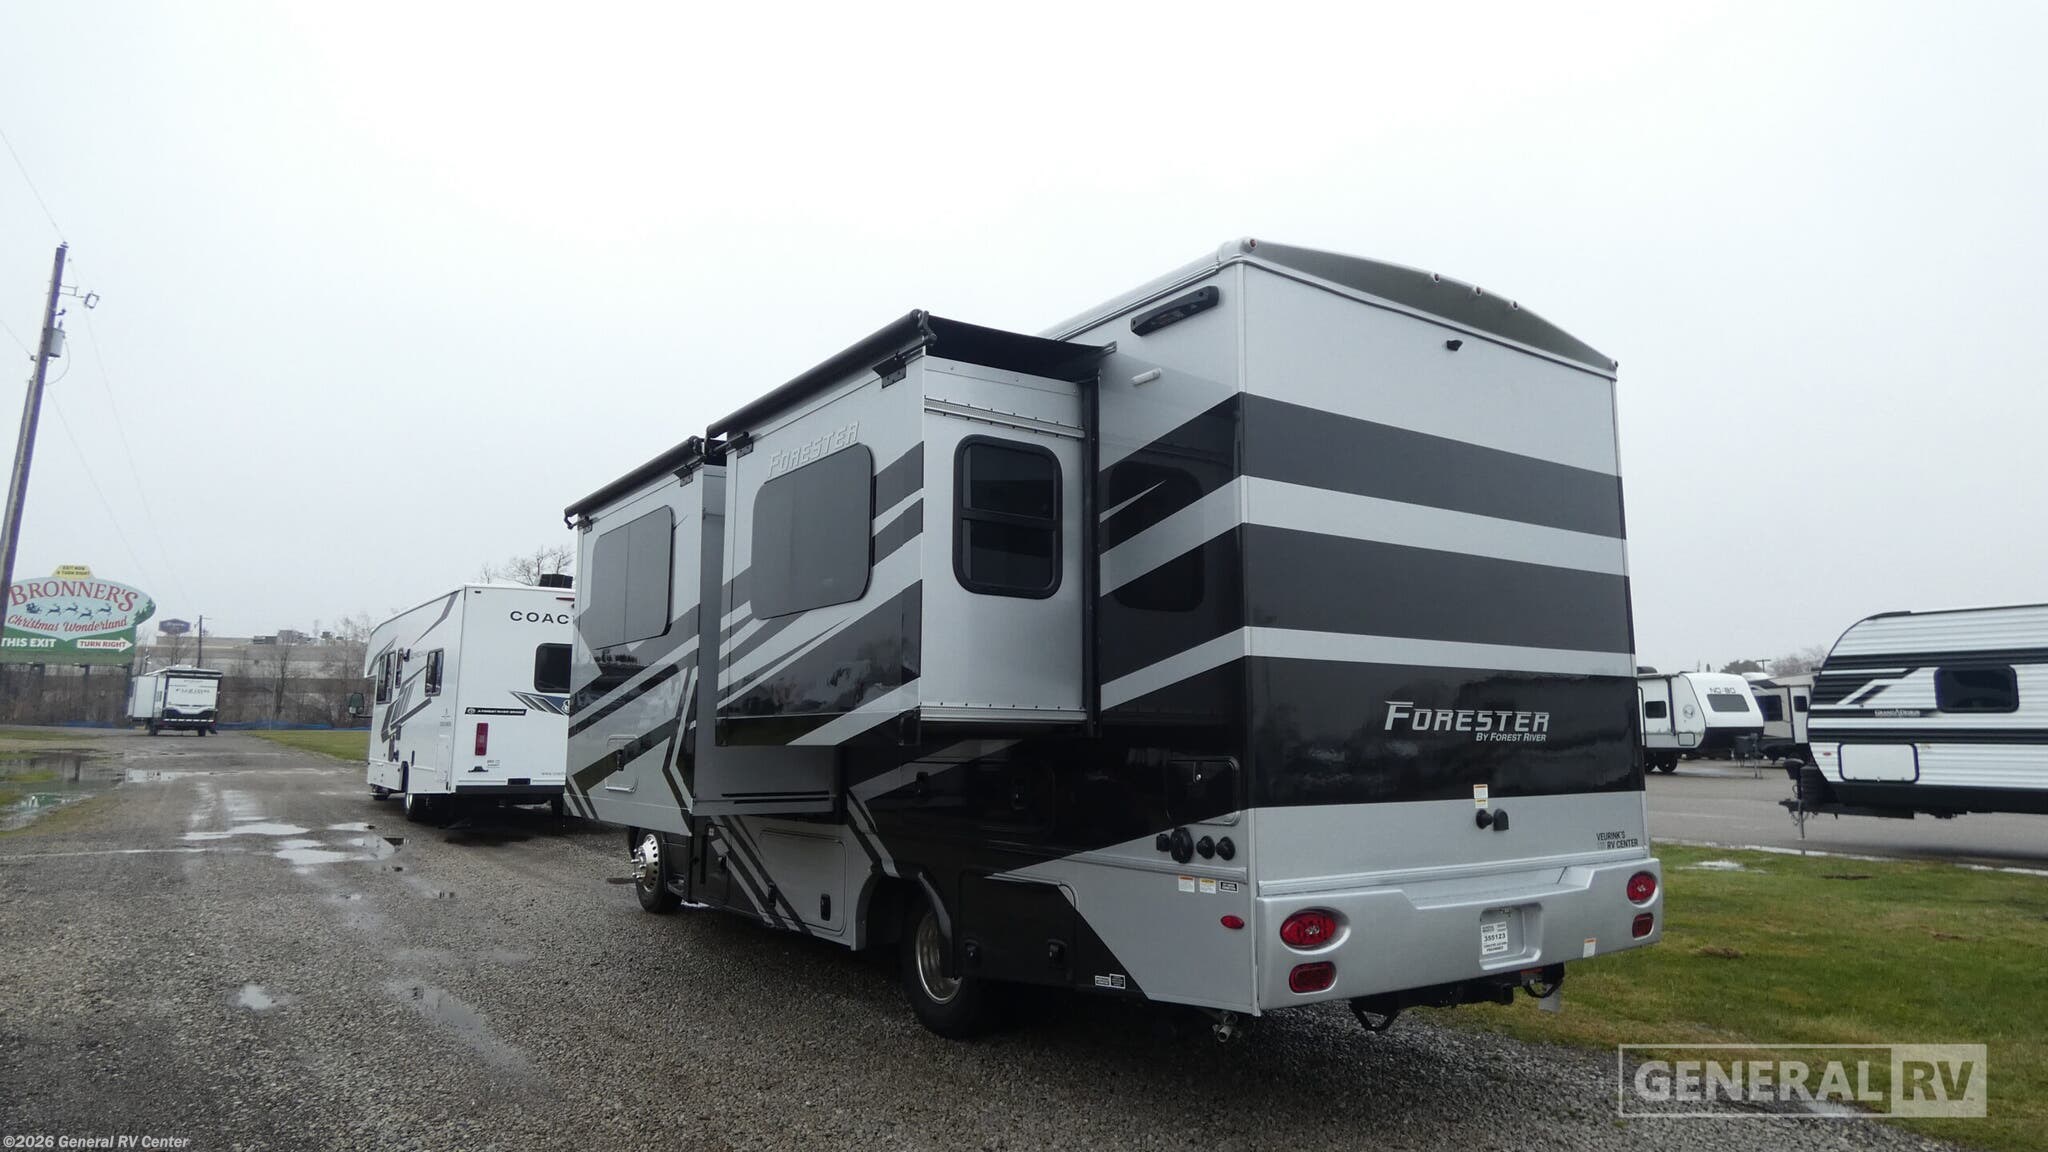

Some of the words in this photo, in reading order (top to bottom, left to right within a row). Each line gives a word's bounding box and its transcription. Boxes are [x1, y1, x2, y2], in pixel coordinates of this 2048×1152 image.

[768, 420, 860, 479] FORESTER
[9, 581, 138, 612] BRONNER'S
[8, 615, 60, 631] Christmas
[63, 616, 127, 632] Wonderland
[510, 610, 574, 625] COAC
[1, 638, 28, 648] THIS
[30, 638, 56, 648] EXIT
[1384, 701, 1550, 732] FORESTER
[1476, 732, 1488, 742] BY
[1490, 732, 1521, 742] FOREST
[1523, 733, 1547, 742] RIVER
[1607, 840, 1615, 849] RV
[1616, 838, 1639, 848] CENTER
[1484, 932, 1506, 942] 355123
